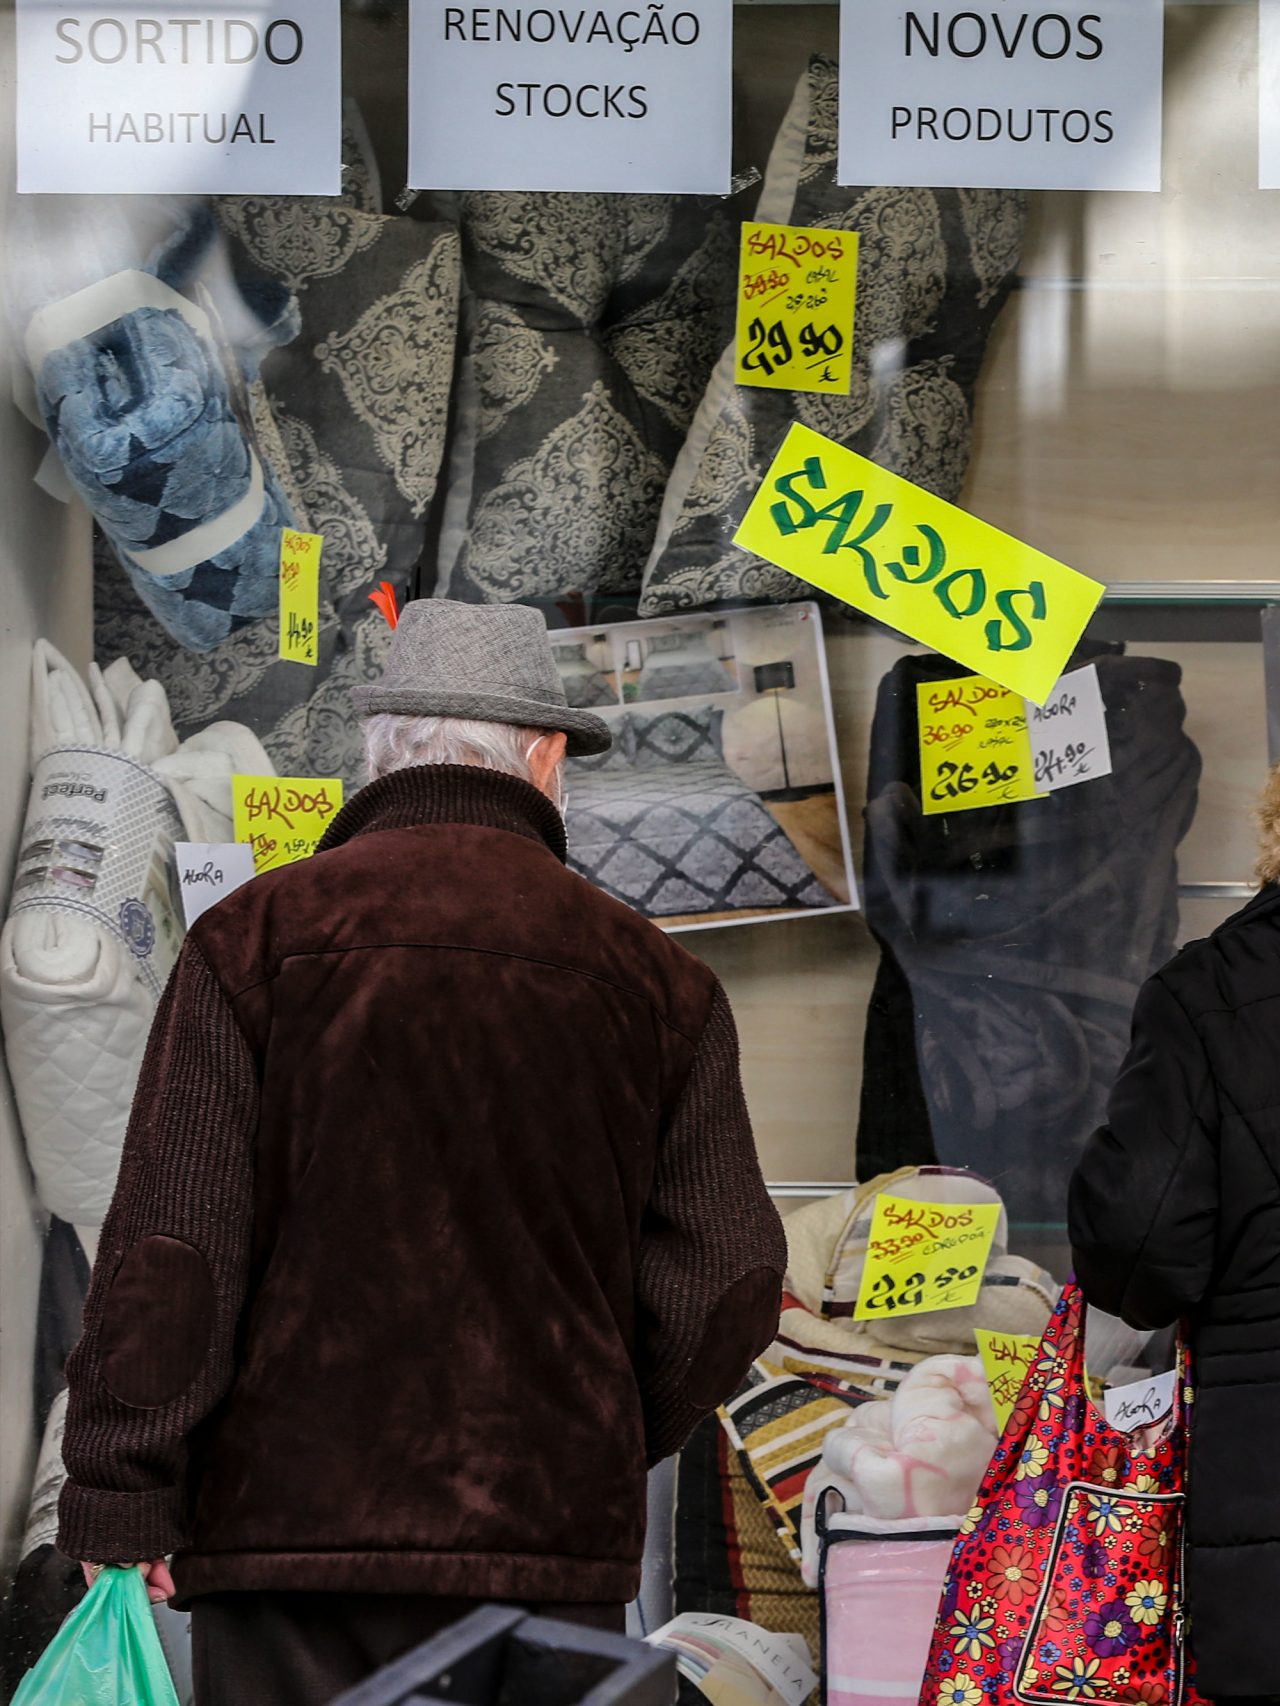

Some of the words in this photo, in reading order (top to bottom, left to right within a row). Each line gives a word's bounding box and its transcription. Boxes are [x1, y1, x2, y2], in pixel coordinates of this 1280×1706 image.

[54, 17, 304, 65] SORTIDO
[443, 3, 700, 52] RENOVAÇÃO
[903, 12, 1104, 61] NOVOS
[495, 82, 648, 119] STOCKS
[88, 111, 276, 146] HABITUAL
[890, 106, 1114, 144] PRODUTOS
[748, 230, 844, 268] SALDOS
[770, 457, 1047, 651] SALDOS
[1033, 693, 1076, 722] AGORA
[42, 783, 107, 804] Perfect
[244, 787, 333, 829] SALDOS
[183, 862, 223, 886] AGORA
[883, 1204, 973, 1239] SALDOS
[1114, 1387, 1161, 1421] AGORA
